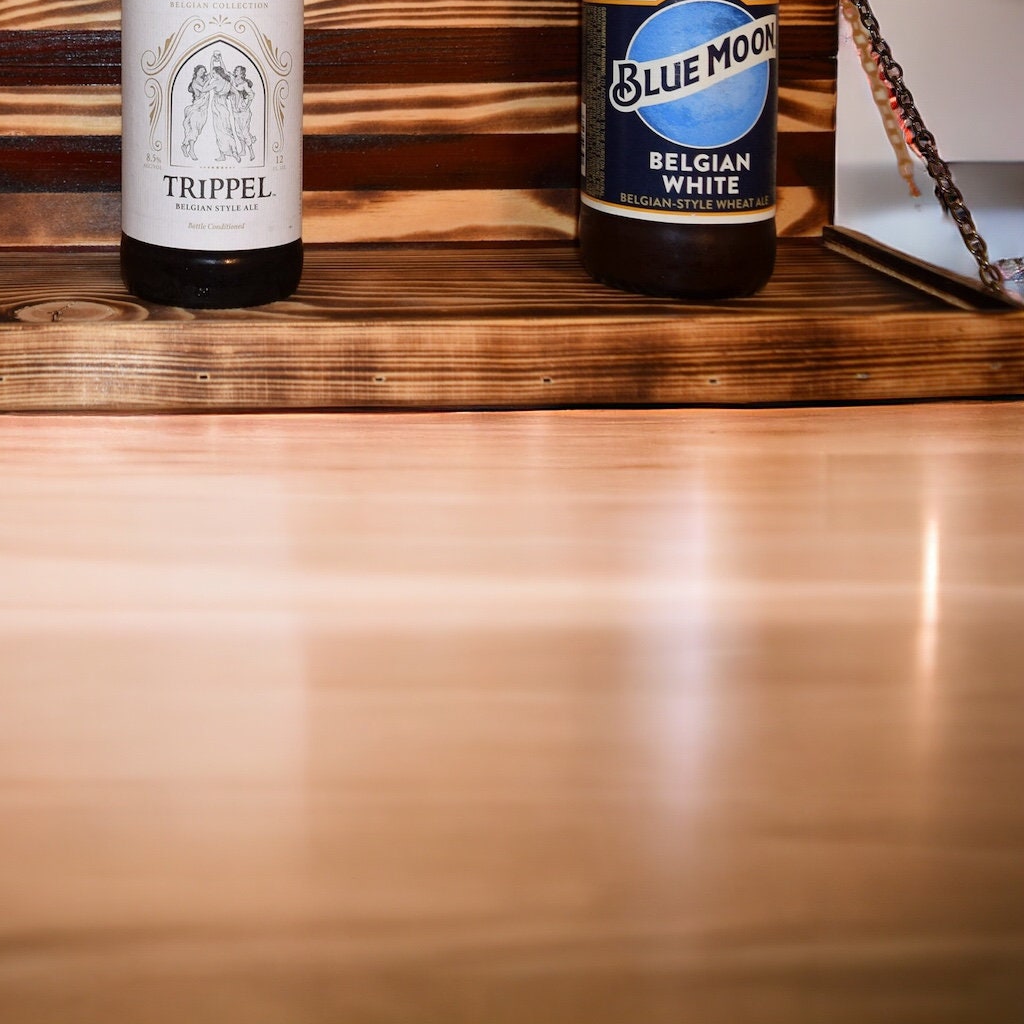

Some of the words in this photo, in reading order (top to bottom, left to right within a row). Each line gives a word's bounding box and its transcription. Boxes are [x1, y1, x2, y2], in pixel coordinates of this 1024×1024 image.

[169, 1, 209, 9] BELGIAN
[612, 54, 699, 107] BLUE
[276, 155, 284, 164] 12
[649, 151, 750, 172] BELGIAN
[662, 175, 739, 195] WHITE
[176, 203, 213, 212] BELGIAN
[215, 204, 241, 212] STYLE
[620, 192, 713, 210] BELGIAN-STYLE
[716, 199, 753, 210] WHEAT
[756, 196, 769, 207] ALE
